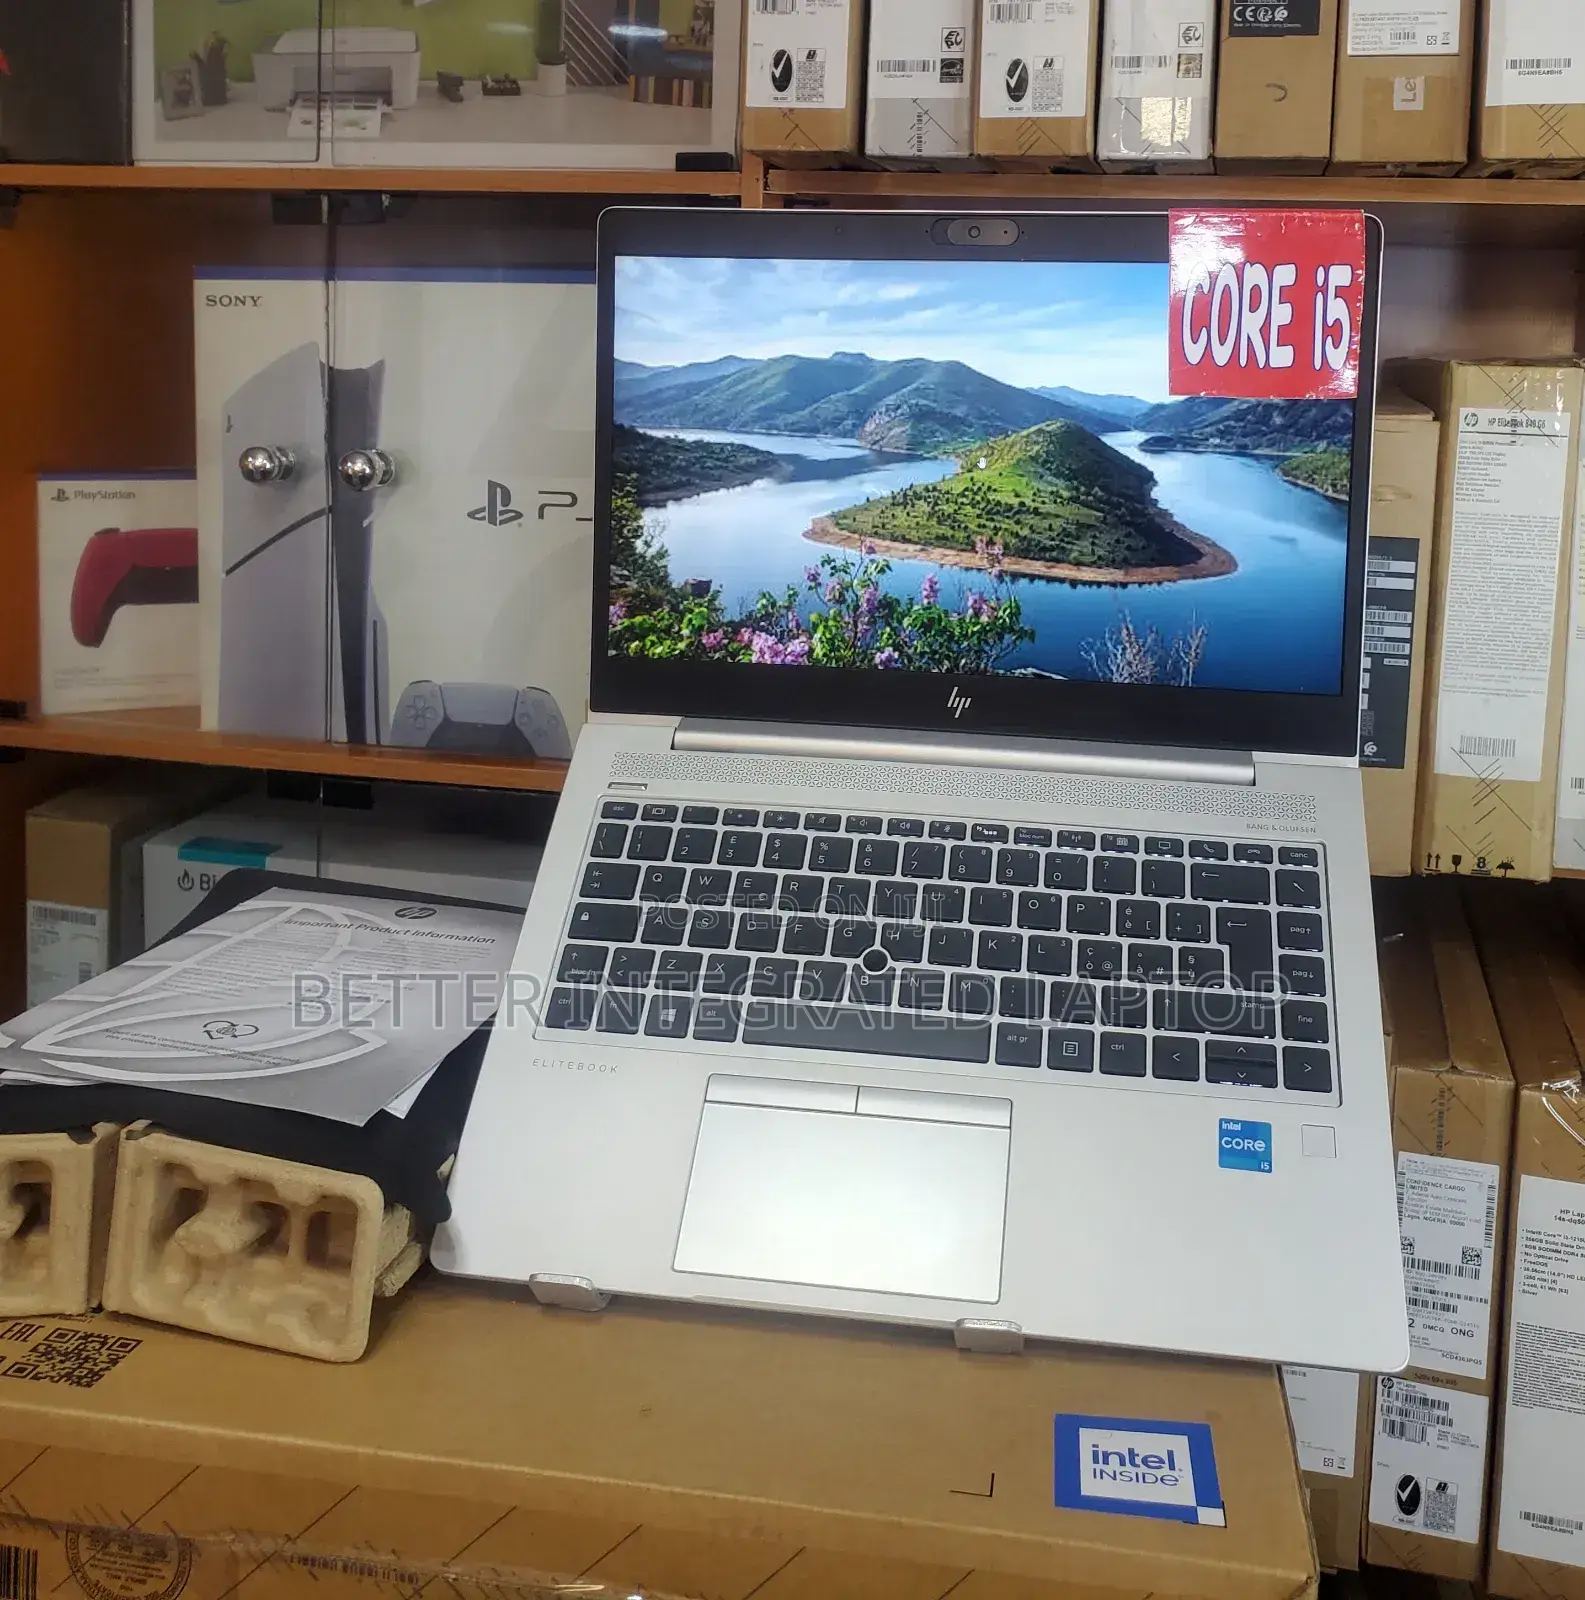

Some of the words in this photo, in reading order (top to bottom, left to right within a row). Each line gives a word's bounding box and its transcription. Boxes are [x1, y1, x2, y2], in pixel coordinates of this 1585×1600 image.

[205, 295, 262, 307] SONY
[1182, 262, 1297, 369] CORE
[1313, 264, 1353, 371] i5
[1488, 418, 1496, 426] HP
[73, 489, 136, 502] PlayStation
[774, 839, 781, 847] $
[820, 842, 829, 850] %
[911, 862, 918, 870] 7
[652, 873, 663, 883] Q
[700, 876, 712, 885] W
[743, 879, 752, 888] E
[790, 882, 798, 890] R
[836, 885, 845, 894] T
[885, 888, 893, 897] Y
[1029, 900, 1039, 909] O
[1077, 904, 1085, 913] P
[654, 916, 664, 925] A
[701, 918, 710, 927] S
[747, 922, 756, 931] D
[794, 925, 803, 933] F
[285, 919, 352, 929] Important
[356, 924, 409, 936] Product
[412, 930, 496, 944] Information
[843, 928, 852, 937] G
[891, 932, 899, 940] H
[939, 935, 946, 945] J
[988, 940, 997, 949] K
[1038, 944, 1045, 954] L
[667, 960, 676, 969] Z
[715, 963, 724, 973] X
[1102, 960, 1113, 971] @
[764, 967, 774, 976] C
[813, 970, 822, 979] V
[1156, 967, 1164, 975] #
[860, 976, 869, 985] B
[910, 977, 919, 987] N
[961, 983, 971, 992] M
[1240, 1001, 1265, 1009] stamp
[532, 1059, 618, 1073] ELITEBOOK
[1222, 1121, 1241, 1131] intel
[1260, 1161, 1270, 1170] i5
[1406, 1178, 1442, 1188] CONFIDENCE
[1444, 1183, 1465, 1191] CARGO
[1534, 1253, 1553, 1262] Optical
[1524, 1259, 1548, 1268] FreeDOS
[1423, 1324, 1444, 1332] DMCQ
[1451, 1327, 1474, 1338] ONG
[1092, 1444, 1176, 1471] intel
